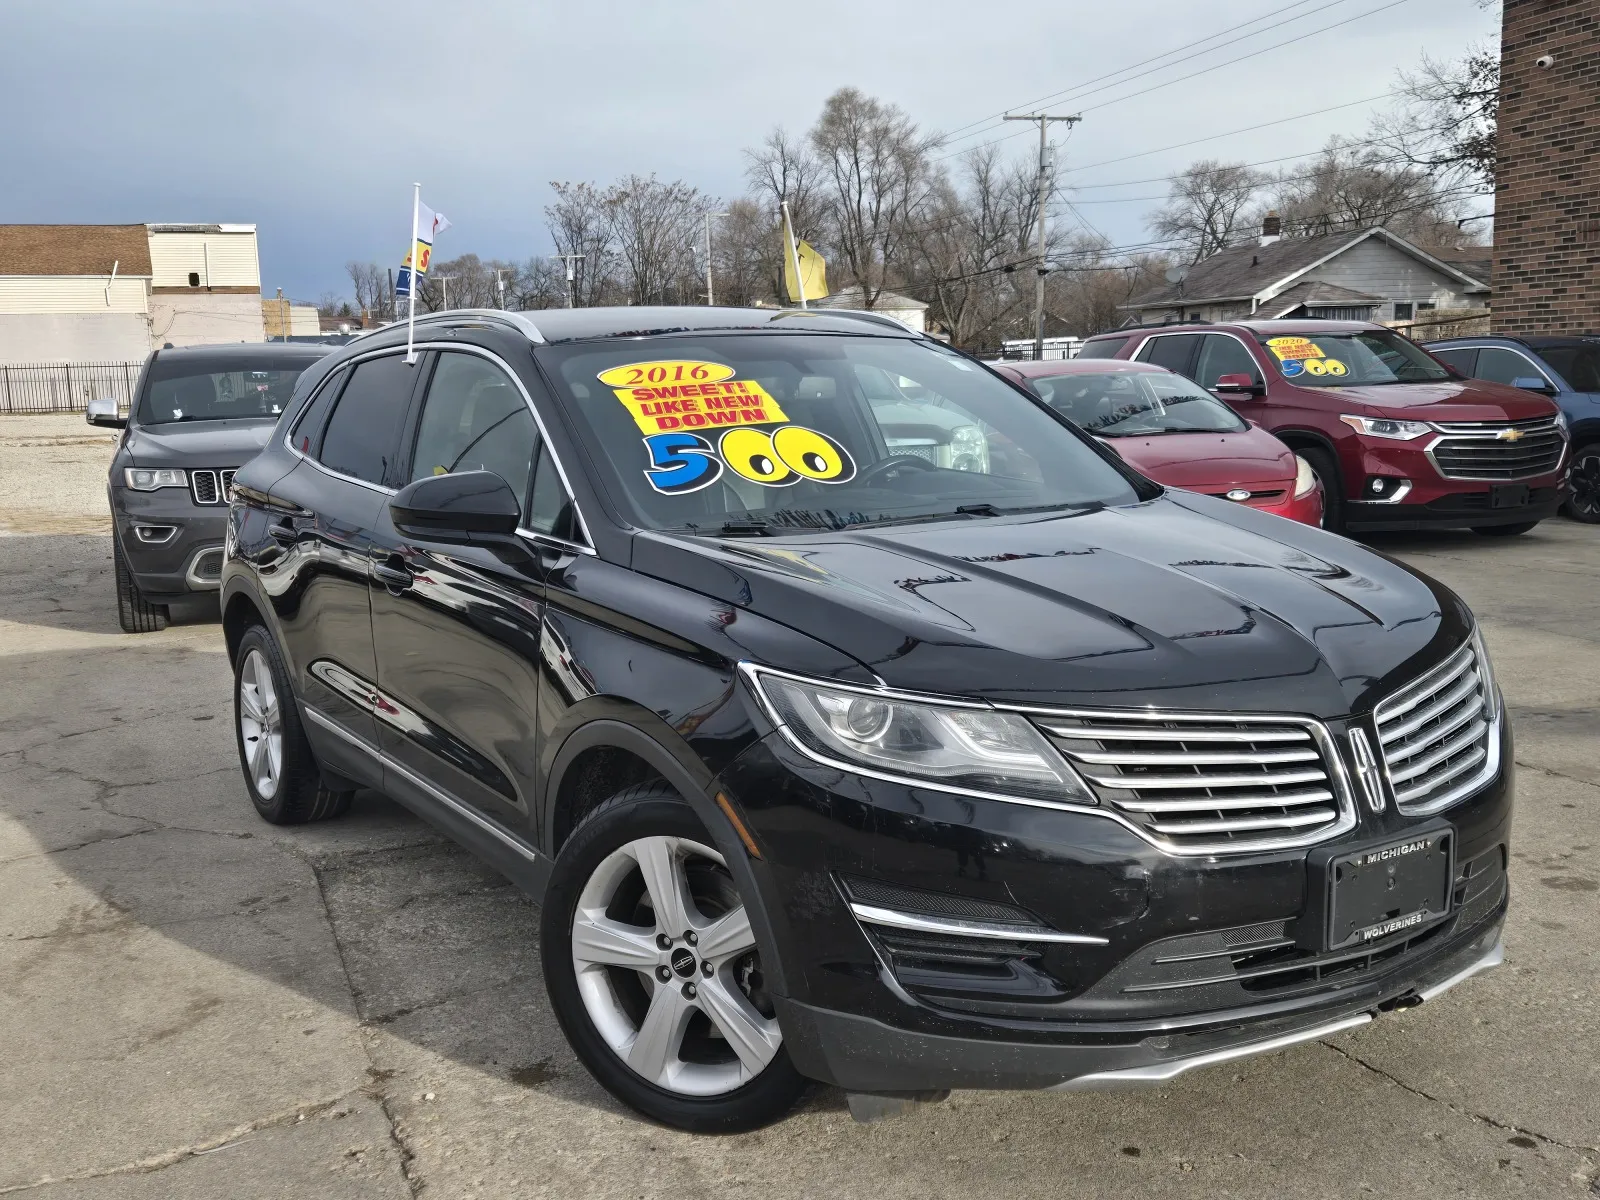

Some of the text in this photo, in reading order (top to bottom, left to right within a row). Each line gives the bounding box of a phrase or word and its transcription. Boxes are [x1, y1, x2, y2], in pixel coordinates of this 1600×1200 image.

[1275, 338, 1303, 346] 2020
[625, 364, 709, 385] 2016
[1281, 359, 1349, 377] 500
[631, 382, 748, 401] SWEET!
[640, 394, 763, 417] LIKE NEW
[655, 408, 769, 431] DOWN
[643, 426, 857, 496] 500
[1367, 840, 1425, 864] MICHIGAN
[1364, 914, 1422, 940] WOLVERINES
